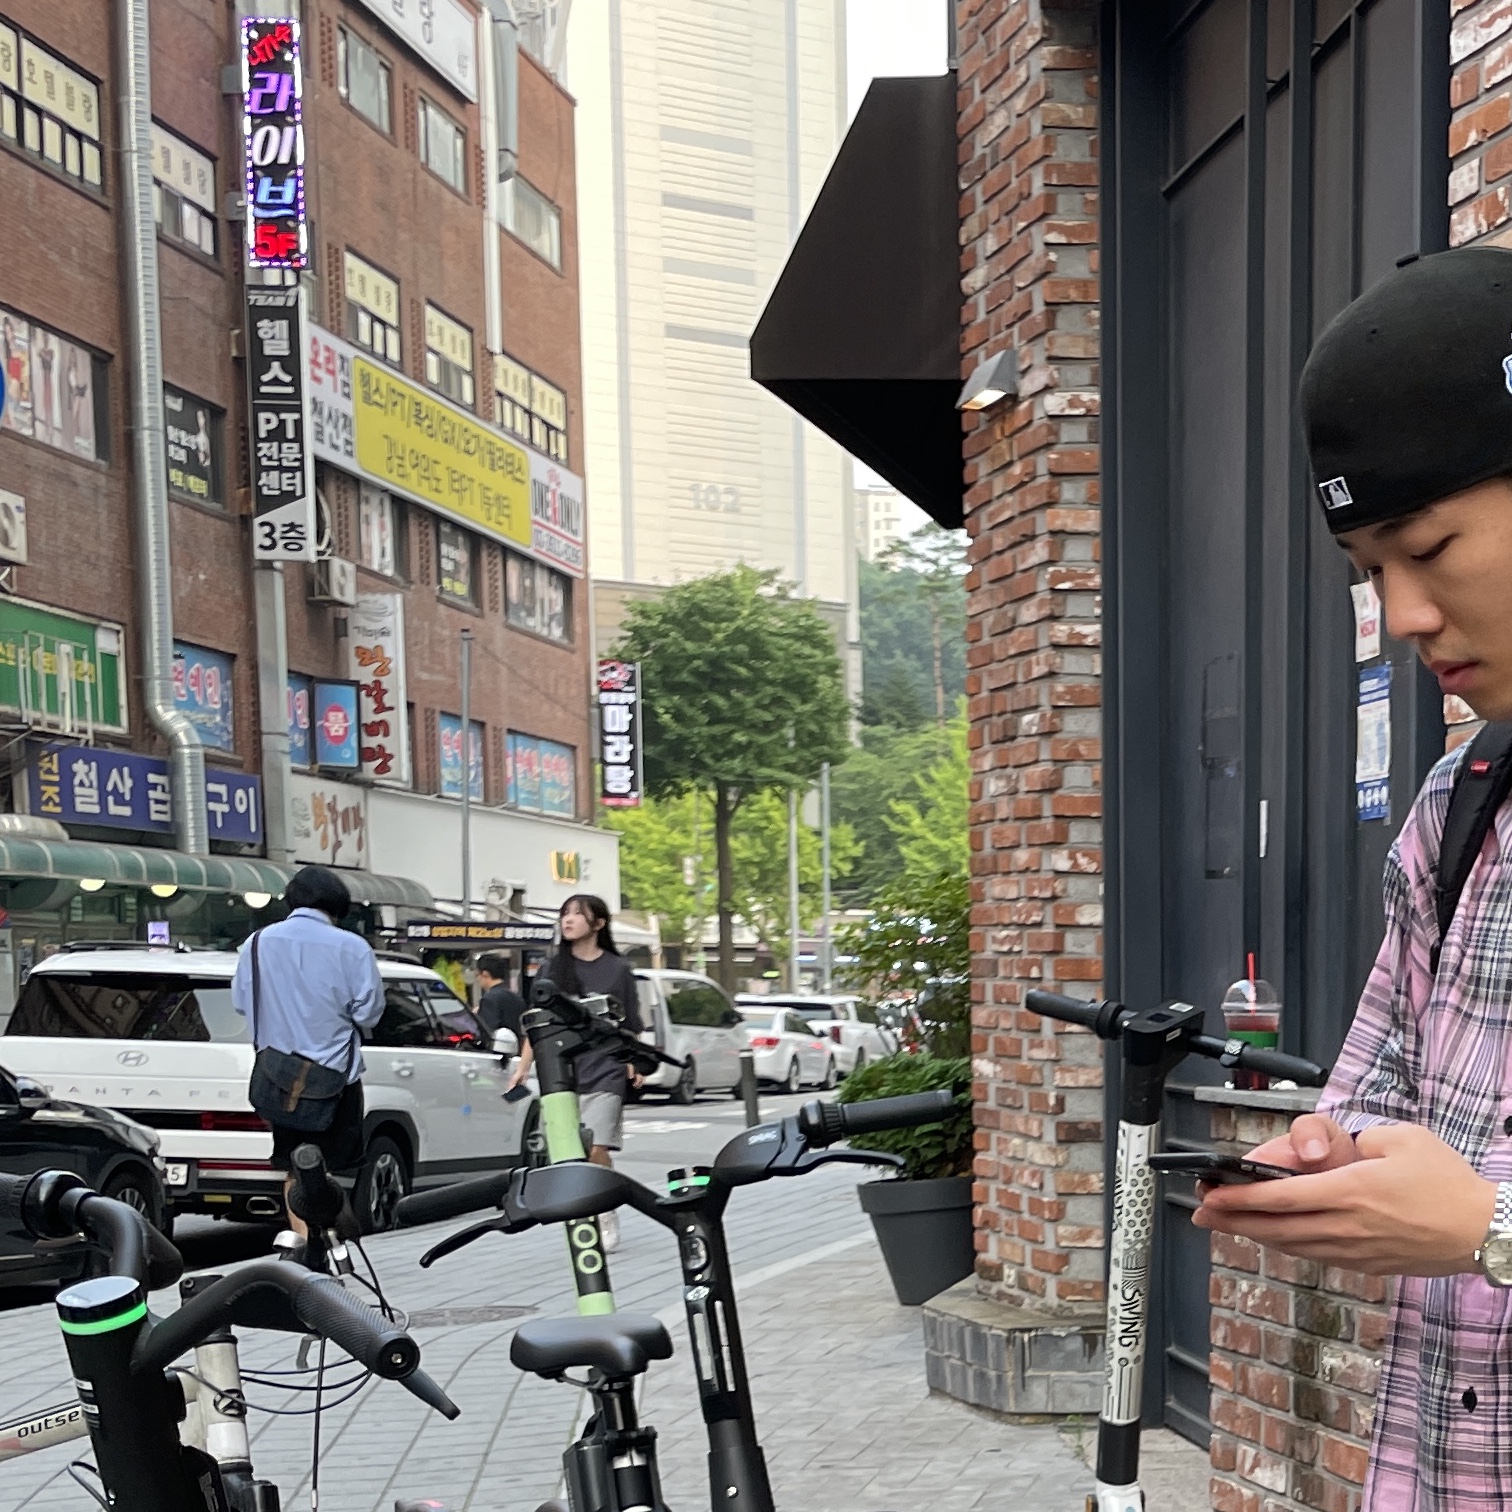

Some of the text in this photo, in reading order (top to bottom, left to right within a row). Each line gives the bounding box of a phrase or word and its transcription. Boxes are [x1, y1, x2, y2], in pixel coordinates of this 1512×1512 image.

[249, 71, 296, 218] 라이브
[255, 225, 298, 258] 5F
[256, 319, 296, 394] 헬스
[257, 411, 300, 439] PT
[257, 442, 302, 467] 전문
[257, 470, 303, 496] 센터
[258, 521, 307, 551] 3층
[603, 704, 635, 793] 마라탕
[72, 759, 133, 817] 철산
[147, 773, 256, 833] 곱구이
[1118, 1287, 1143, 1348] SWING
[18, 1410, 81, 1438] outse
